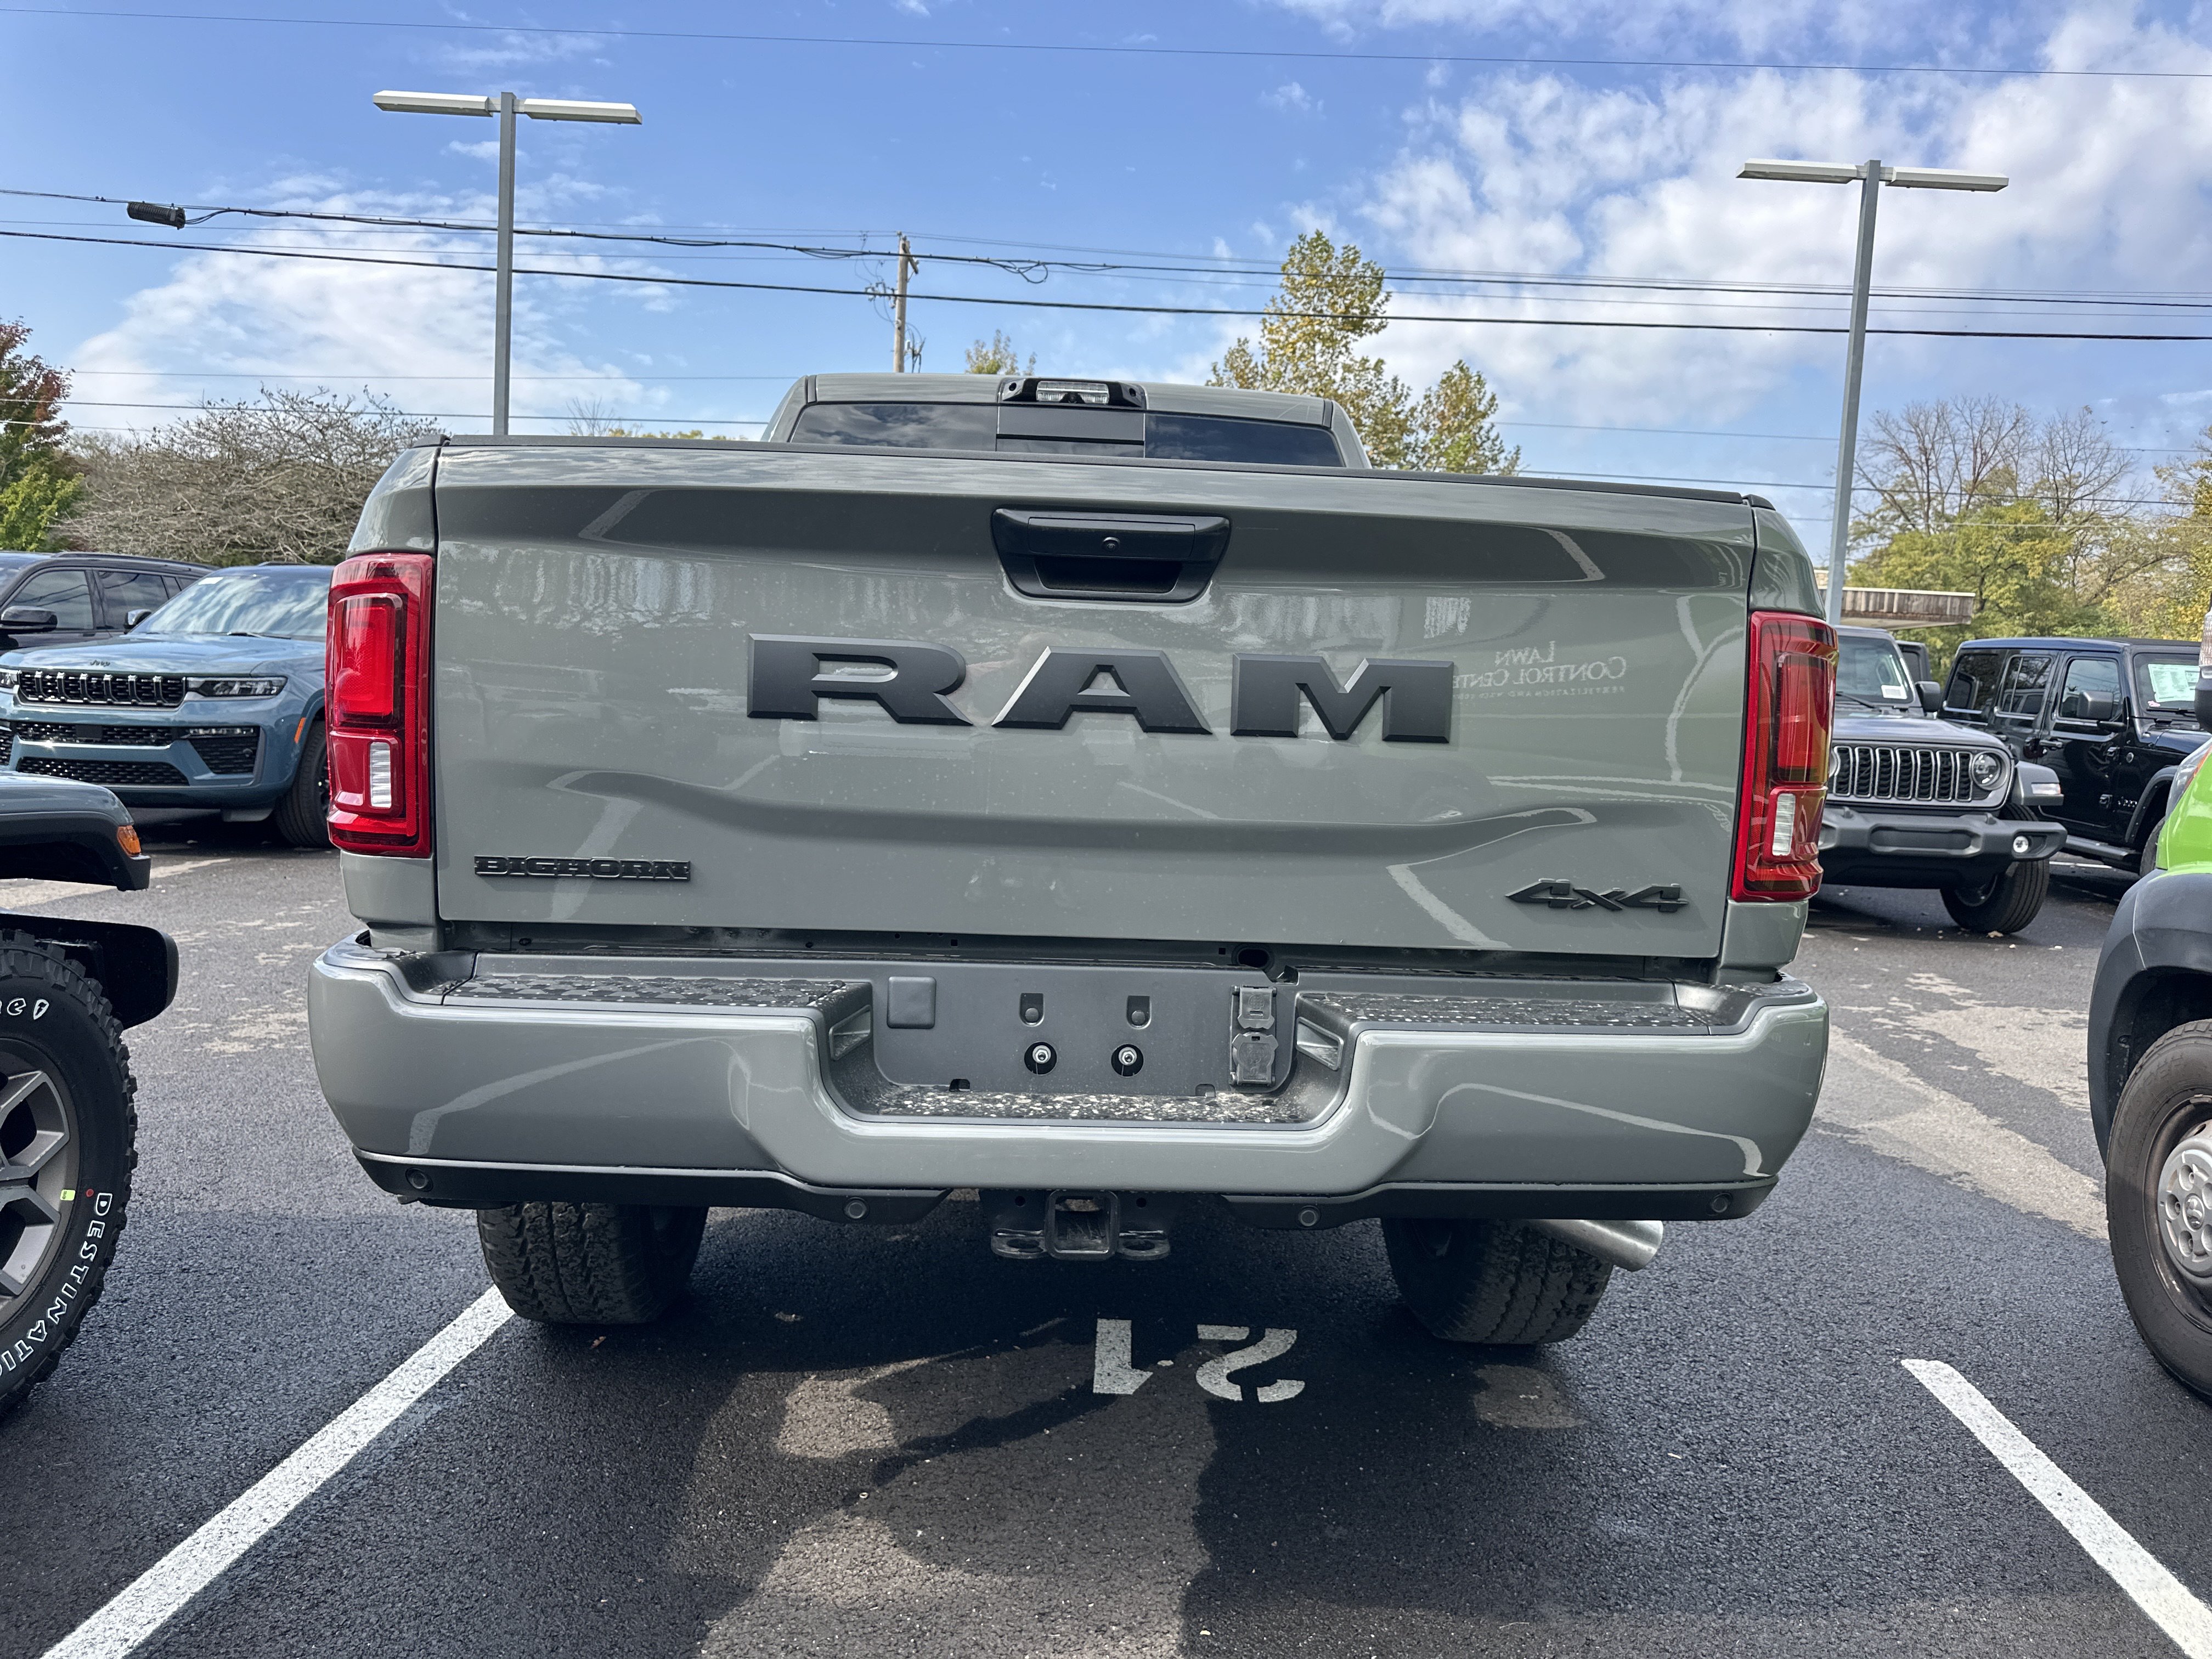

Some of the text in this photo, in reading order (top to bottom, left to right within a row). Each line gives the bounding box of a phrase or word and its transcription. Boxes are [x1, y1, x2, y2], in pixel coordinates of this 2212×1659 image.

[746, 632, 1454, 743] RAM
[474, 855, 691, 881] BIGHORN
[0, 1193, 113, 1376] DESTINATI
